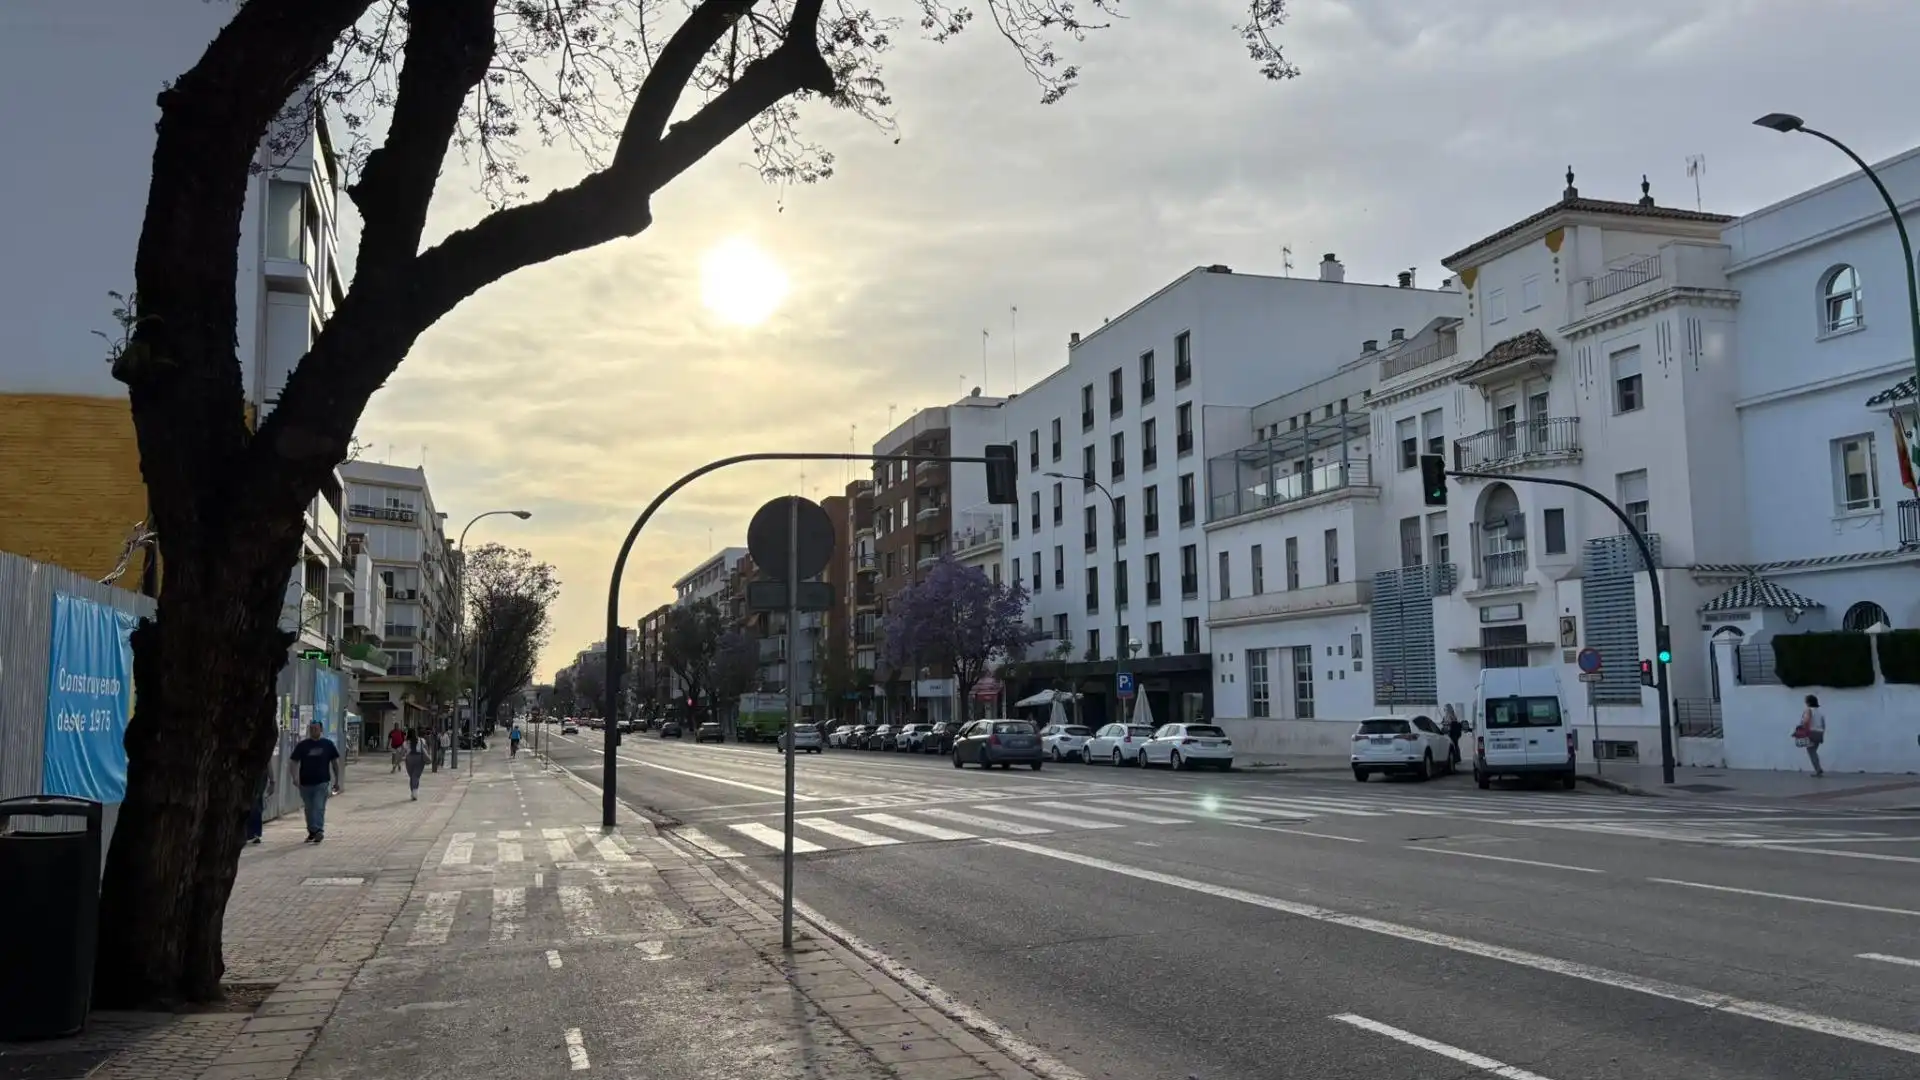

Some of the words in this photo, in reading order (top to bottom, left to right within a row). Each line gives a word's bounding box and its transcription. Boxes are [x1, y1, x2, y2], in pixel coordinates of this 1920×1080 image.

[59, 667, 121, 699] Construyendo
[57, 708, 86, 732] desde
[89, 708, 111, 732] 1975
